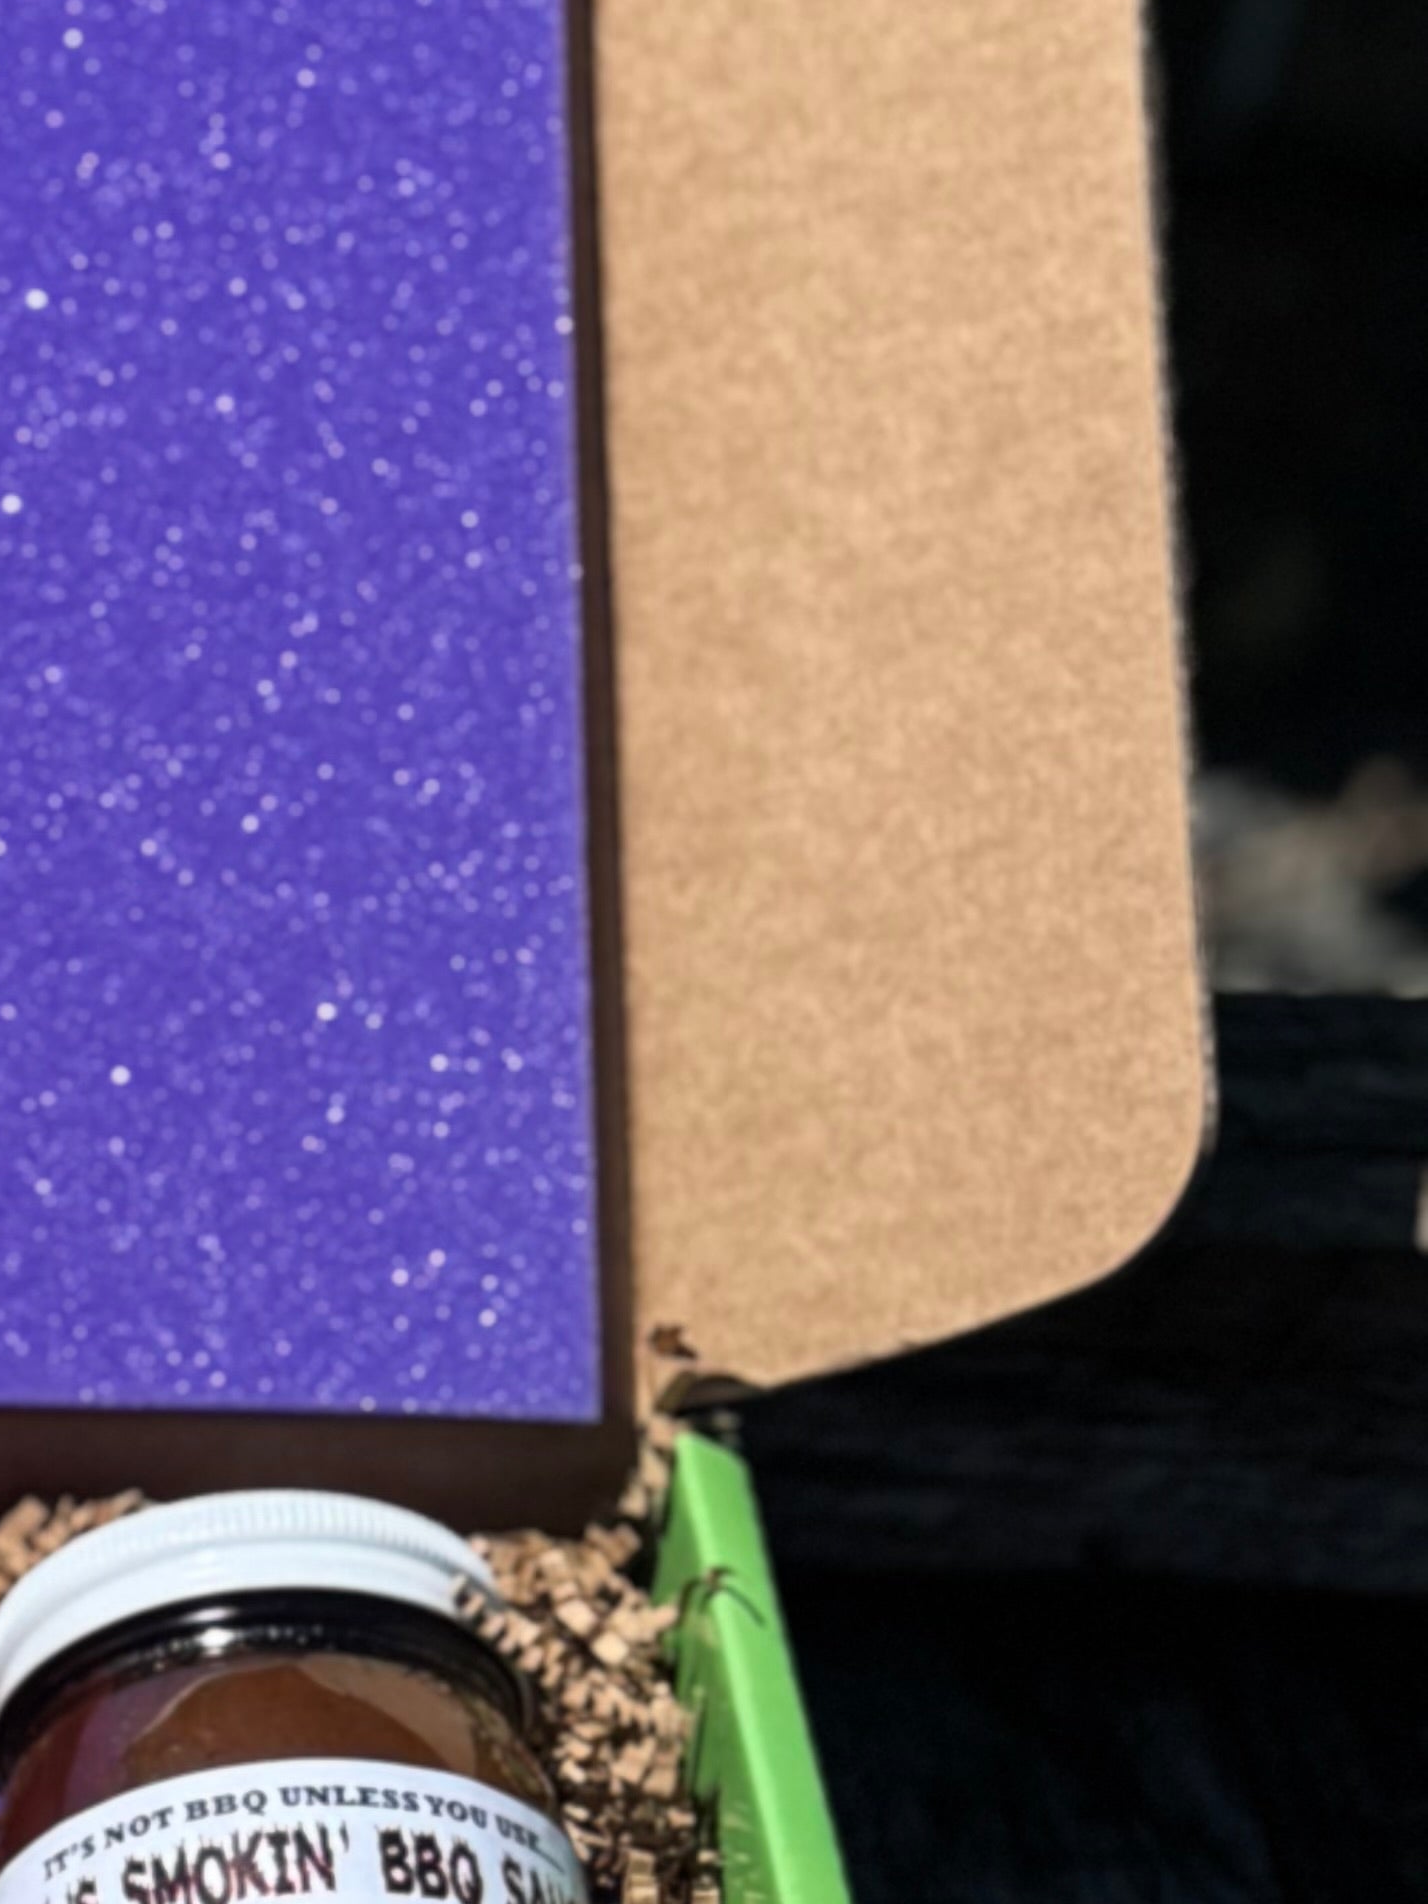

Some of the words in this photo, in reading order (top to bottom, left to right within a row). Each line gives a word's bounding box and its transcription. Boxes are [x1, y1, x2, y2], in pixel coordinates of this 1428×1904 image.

[42, 1835, 96, 1881] IT'S
[104, 1806, 175, 1848] NOT
[184, 1789, 268, 1822] BBQ
[278, 1785, 420, 1812] UNLESS
[423, 1794, 487, 1829] YOU
